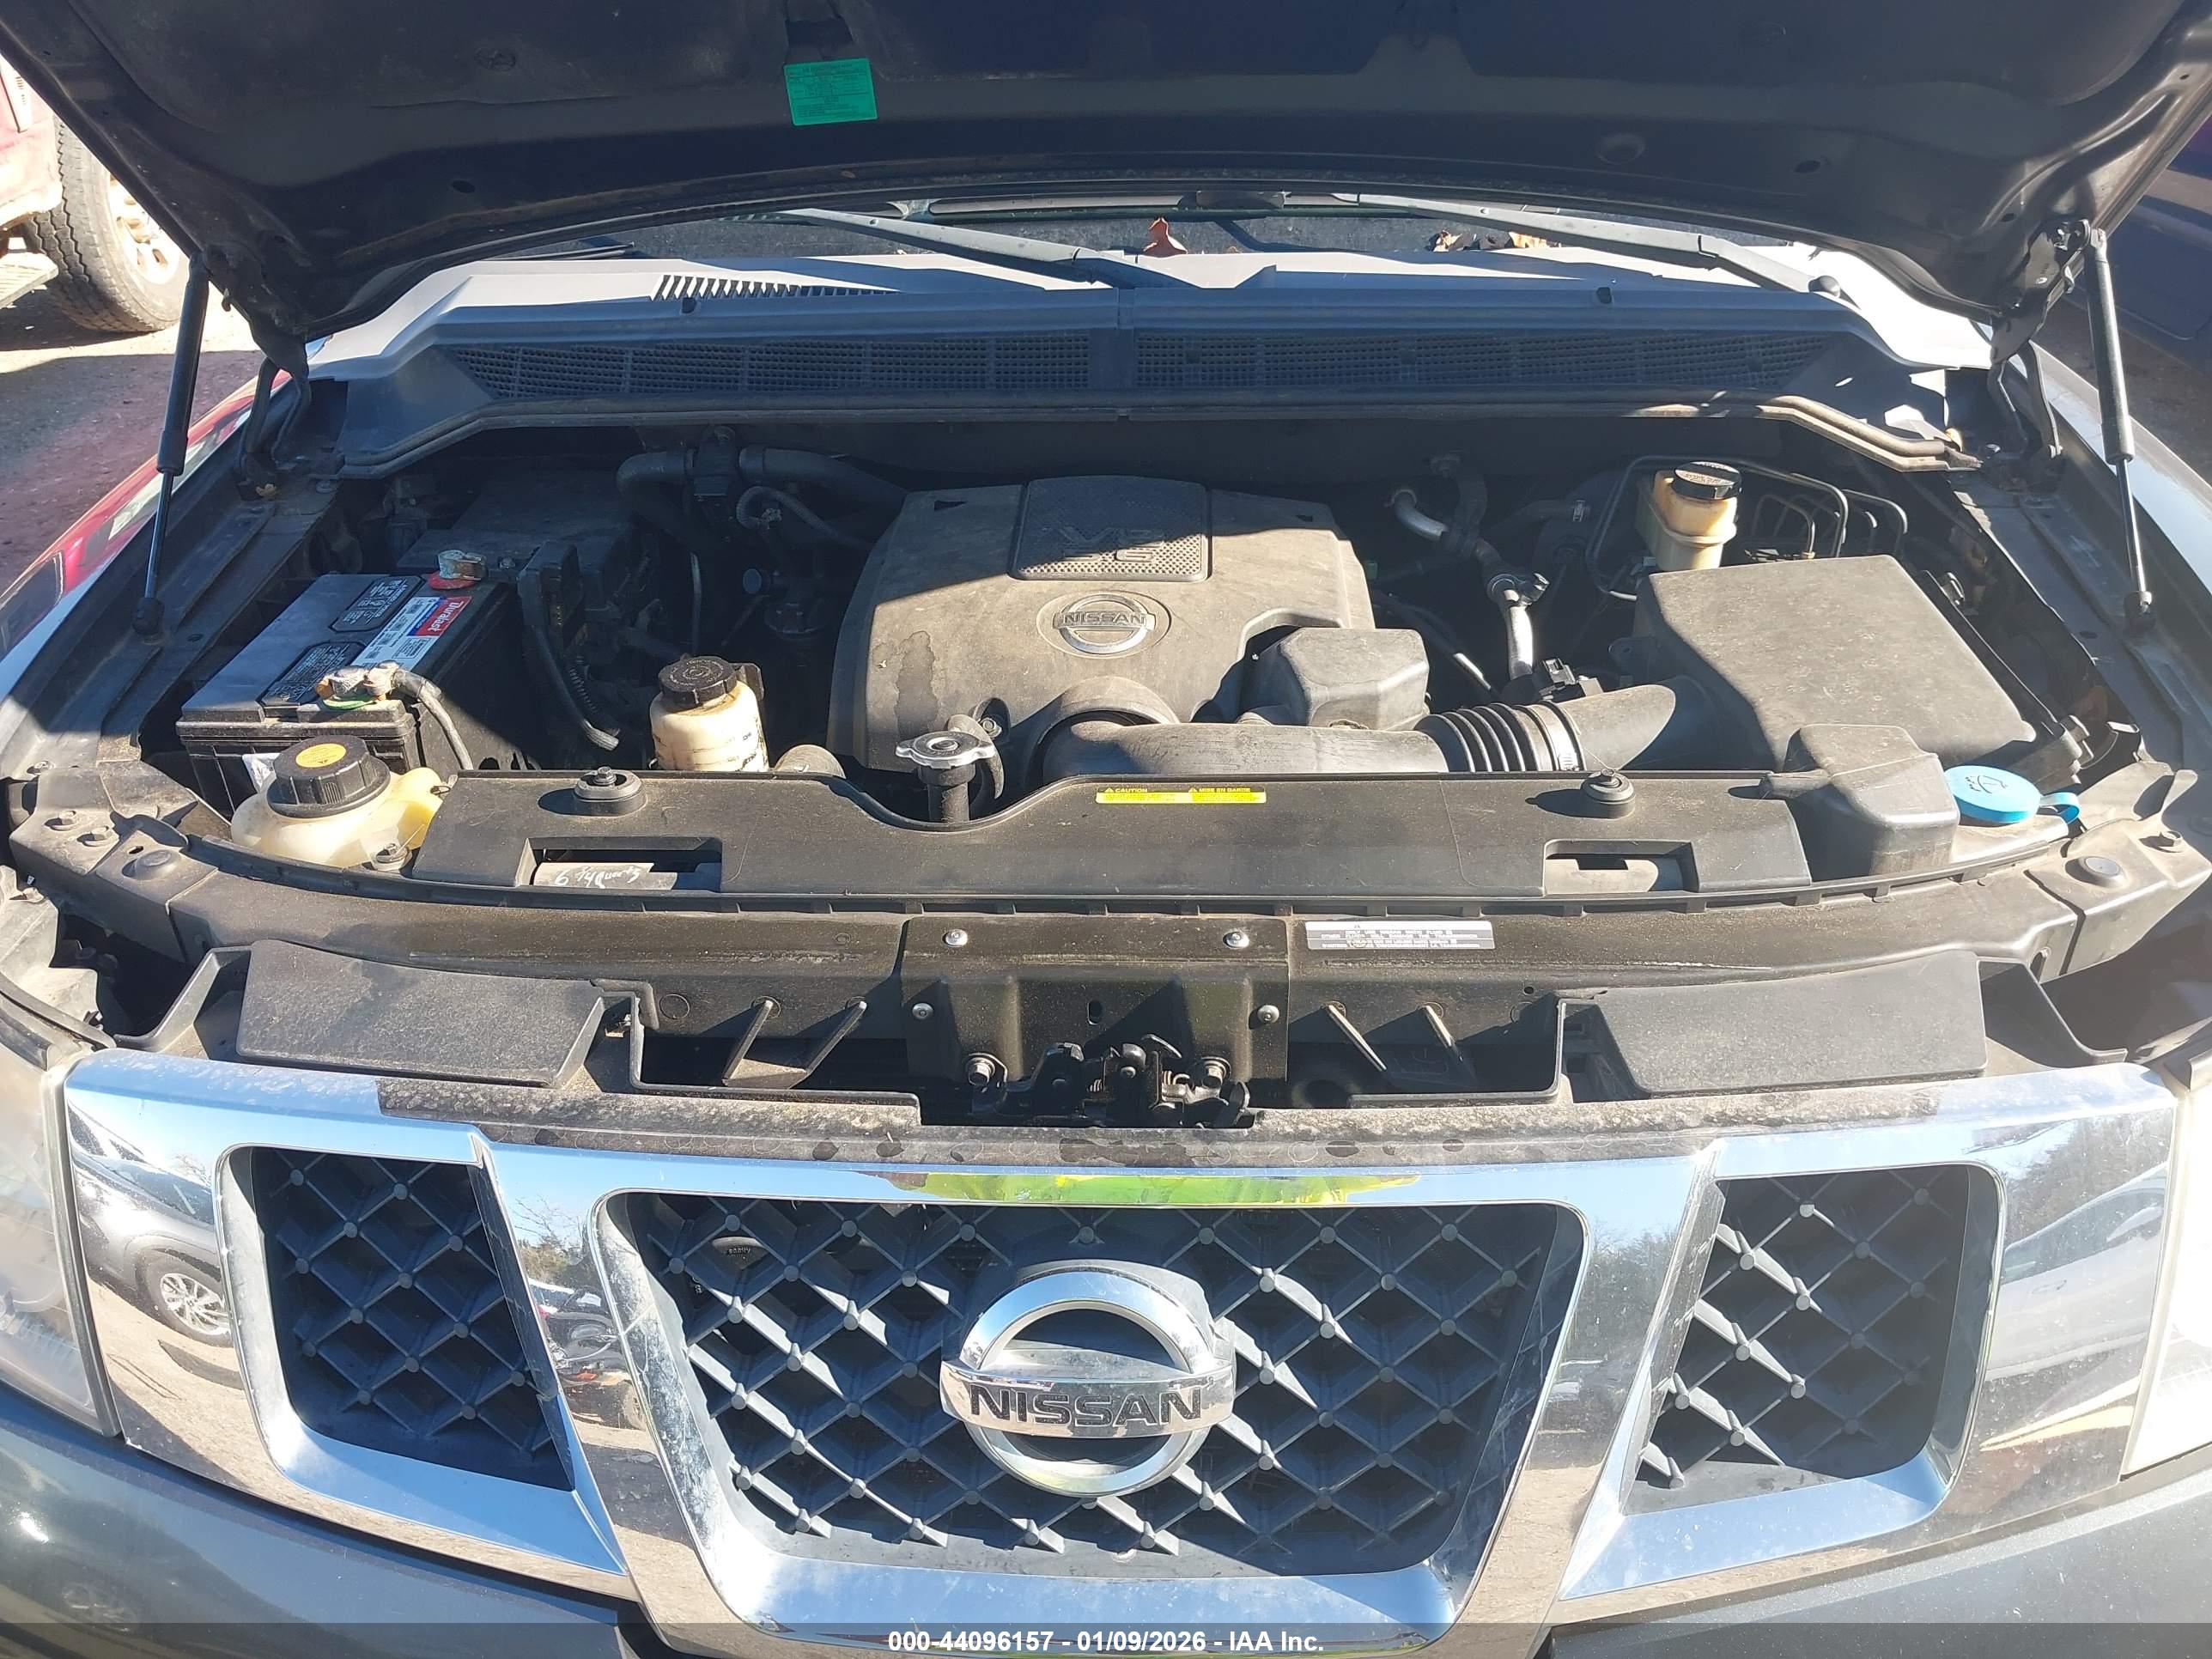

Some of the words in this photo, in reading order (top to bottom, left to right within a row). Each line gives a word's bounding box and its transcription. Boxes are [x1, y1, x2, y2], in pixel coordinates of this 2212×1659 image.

[427, 600, 465, 632] Duralast
[1064, 611, 1145, 626] NISSAN
[554, 868, 570, 886] 6
[970, 1383, 1201, 1426] NISSAN
